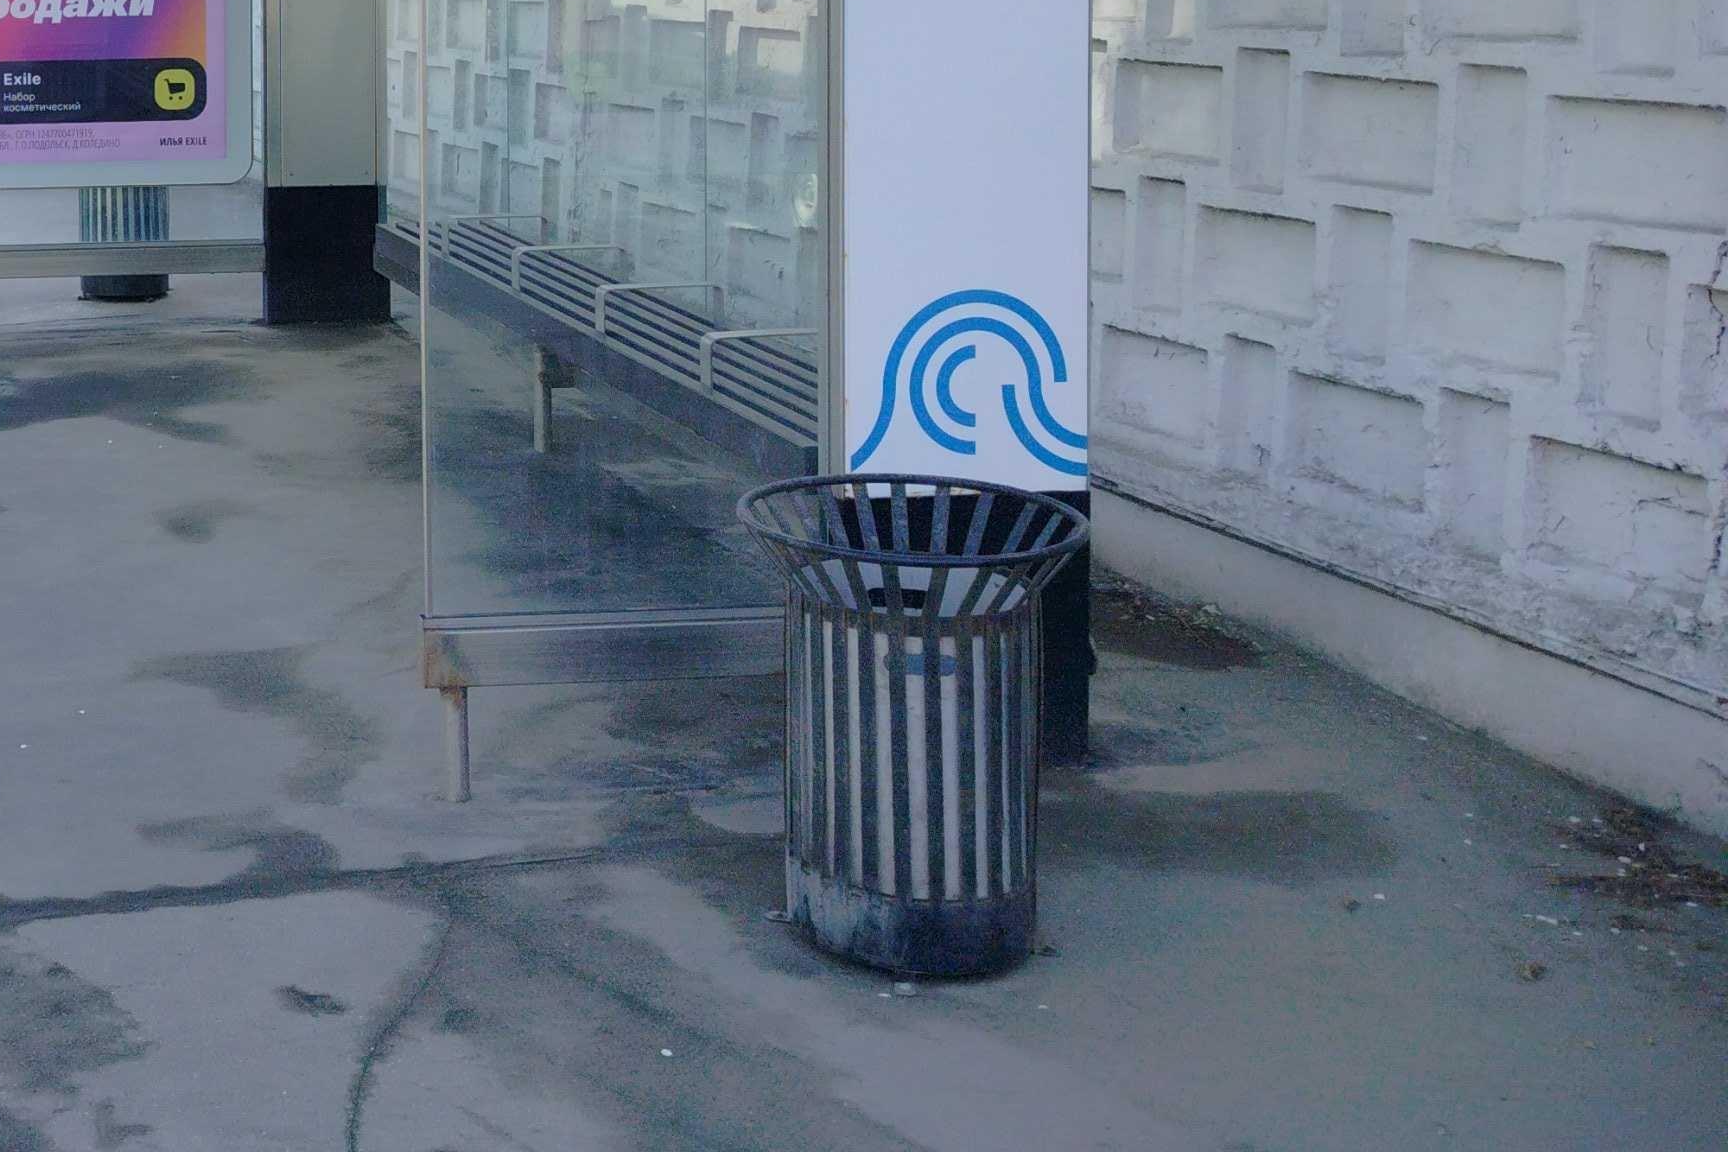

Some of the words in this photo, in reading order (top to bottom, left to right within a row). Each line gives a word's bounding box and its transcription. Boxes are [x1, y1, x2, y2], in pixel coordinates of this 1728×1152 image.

[3, 72, 42, 86] Exile
[3, 90, 36, 103] Набор
[3, 101, 81, 113] косметический
[160, 137, 183, 146] ИЛЬЯ
[186, 136, 208, 145] EXILE
